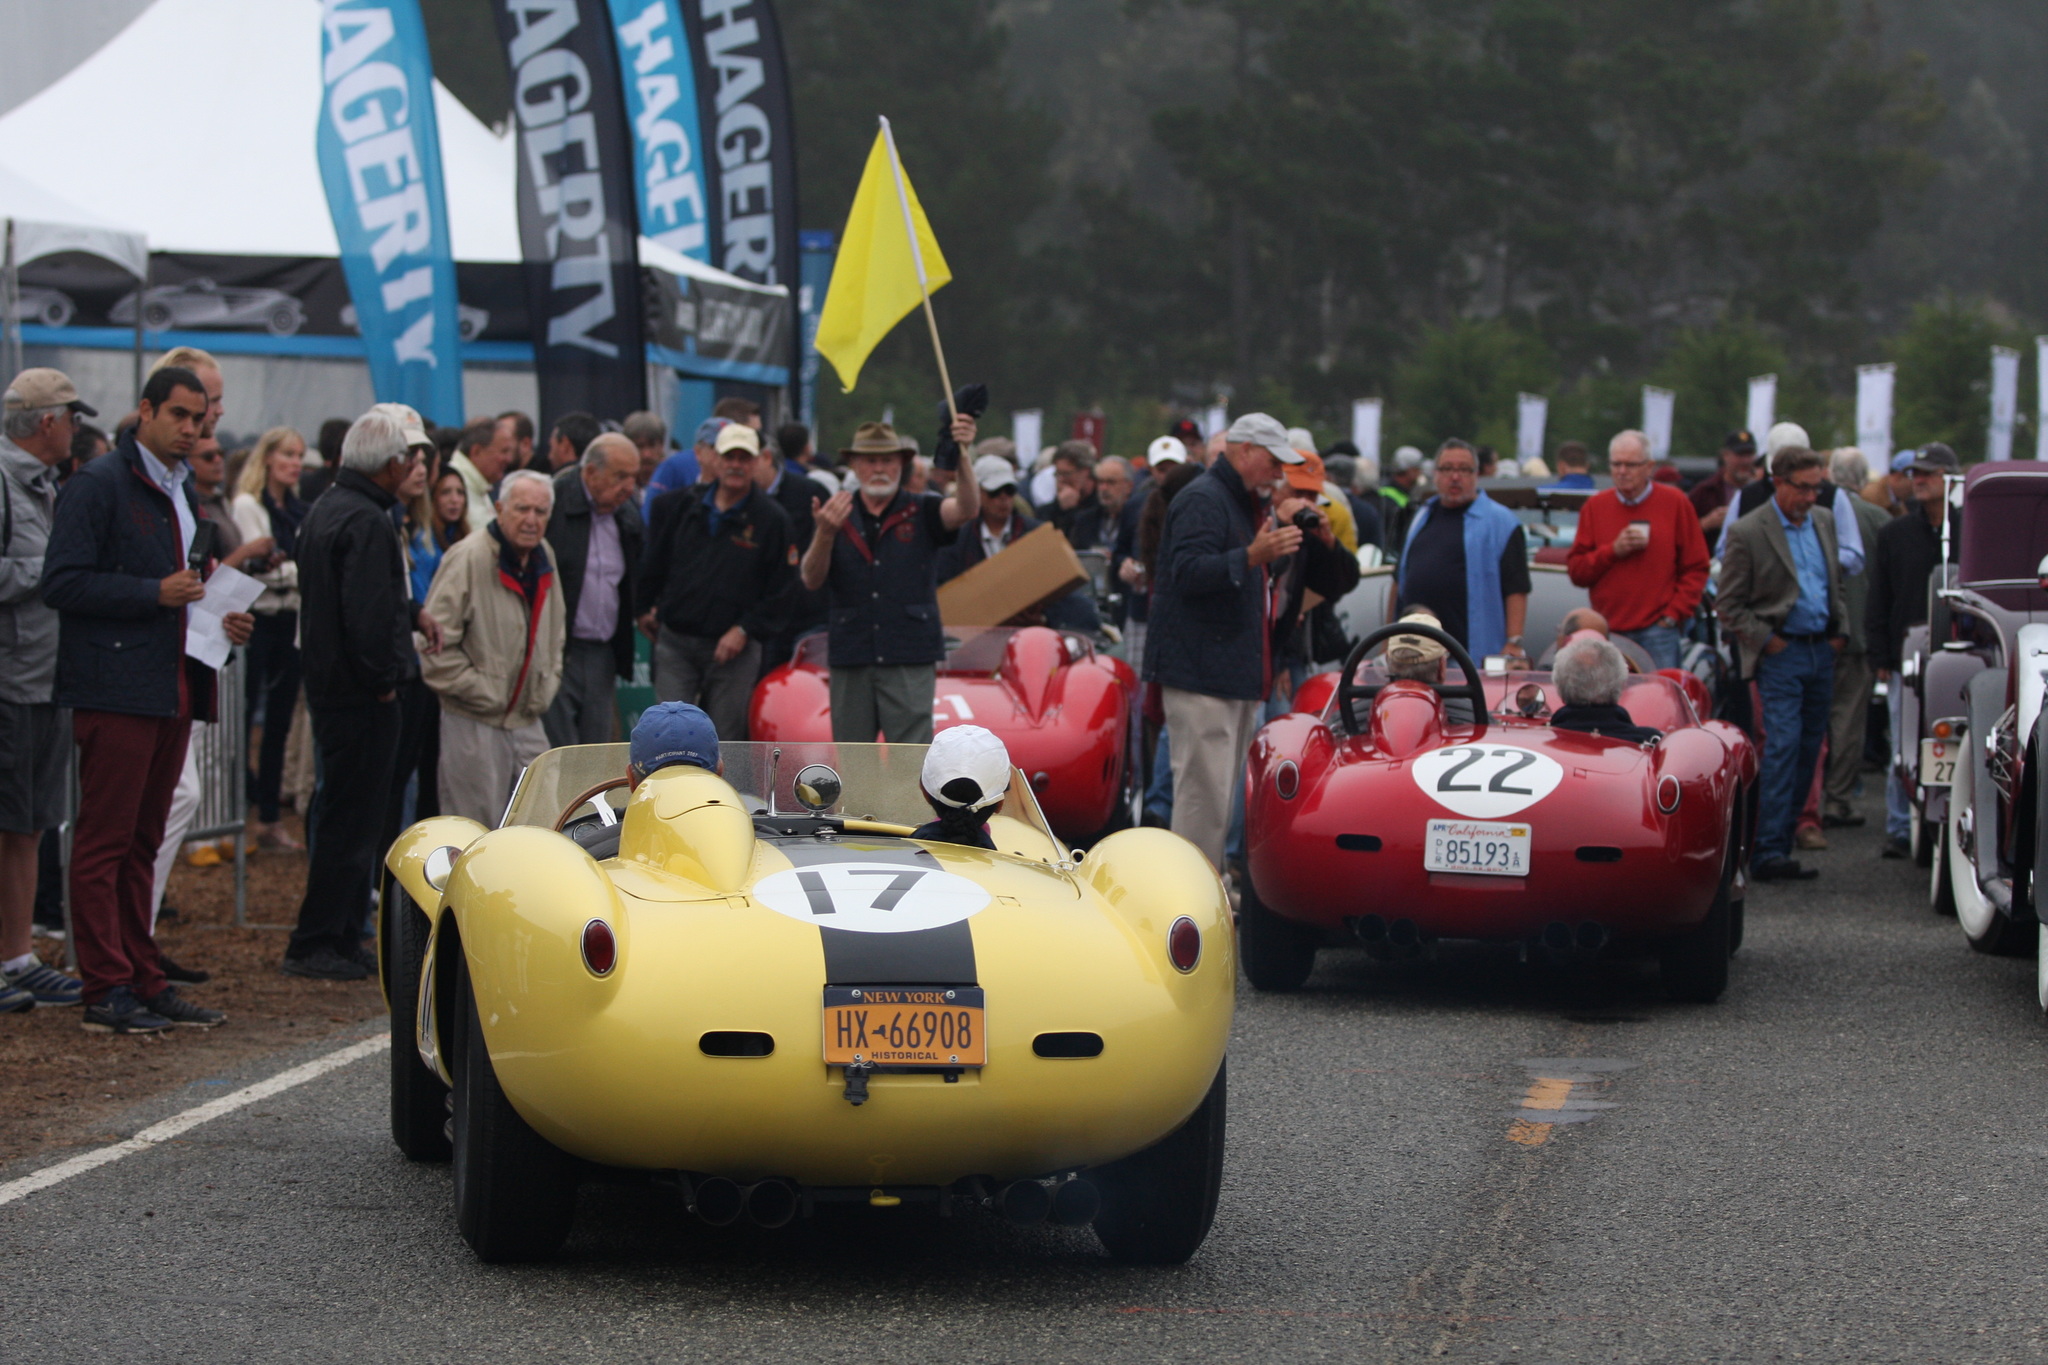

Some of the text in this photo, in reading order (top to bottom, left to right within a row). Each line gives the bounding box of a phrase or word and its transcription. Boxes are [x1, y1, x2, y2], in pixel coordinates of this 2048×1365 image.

[701, 0, 777, 285] HAGER
[323, 0, 438, 369] AGERTY
[1437, 747, 1537, 795] 22
[1935, 761, 1956, 782] 27
[1433, 824, 1447, 832] APR
[1448, 823, 1508, 840] California
[1446, 840, 1510, 866] 85193
[795, 869, 928, 915] 17
[863, 991, 946, 1003] NEW YORK
[871, 1051, 939, 1060] HISTORICAL
